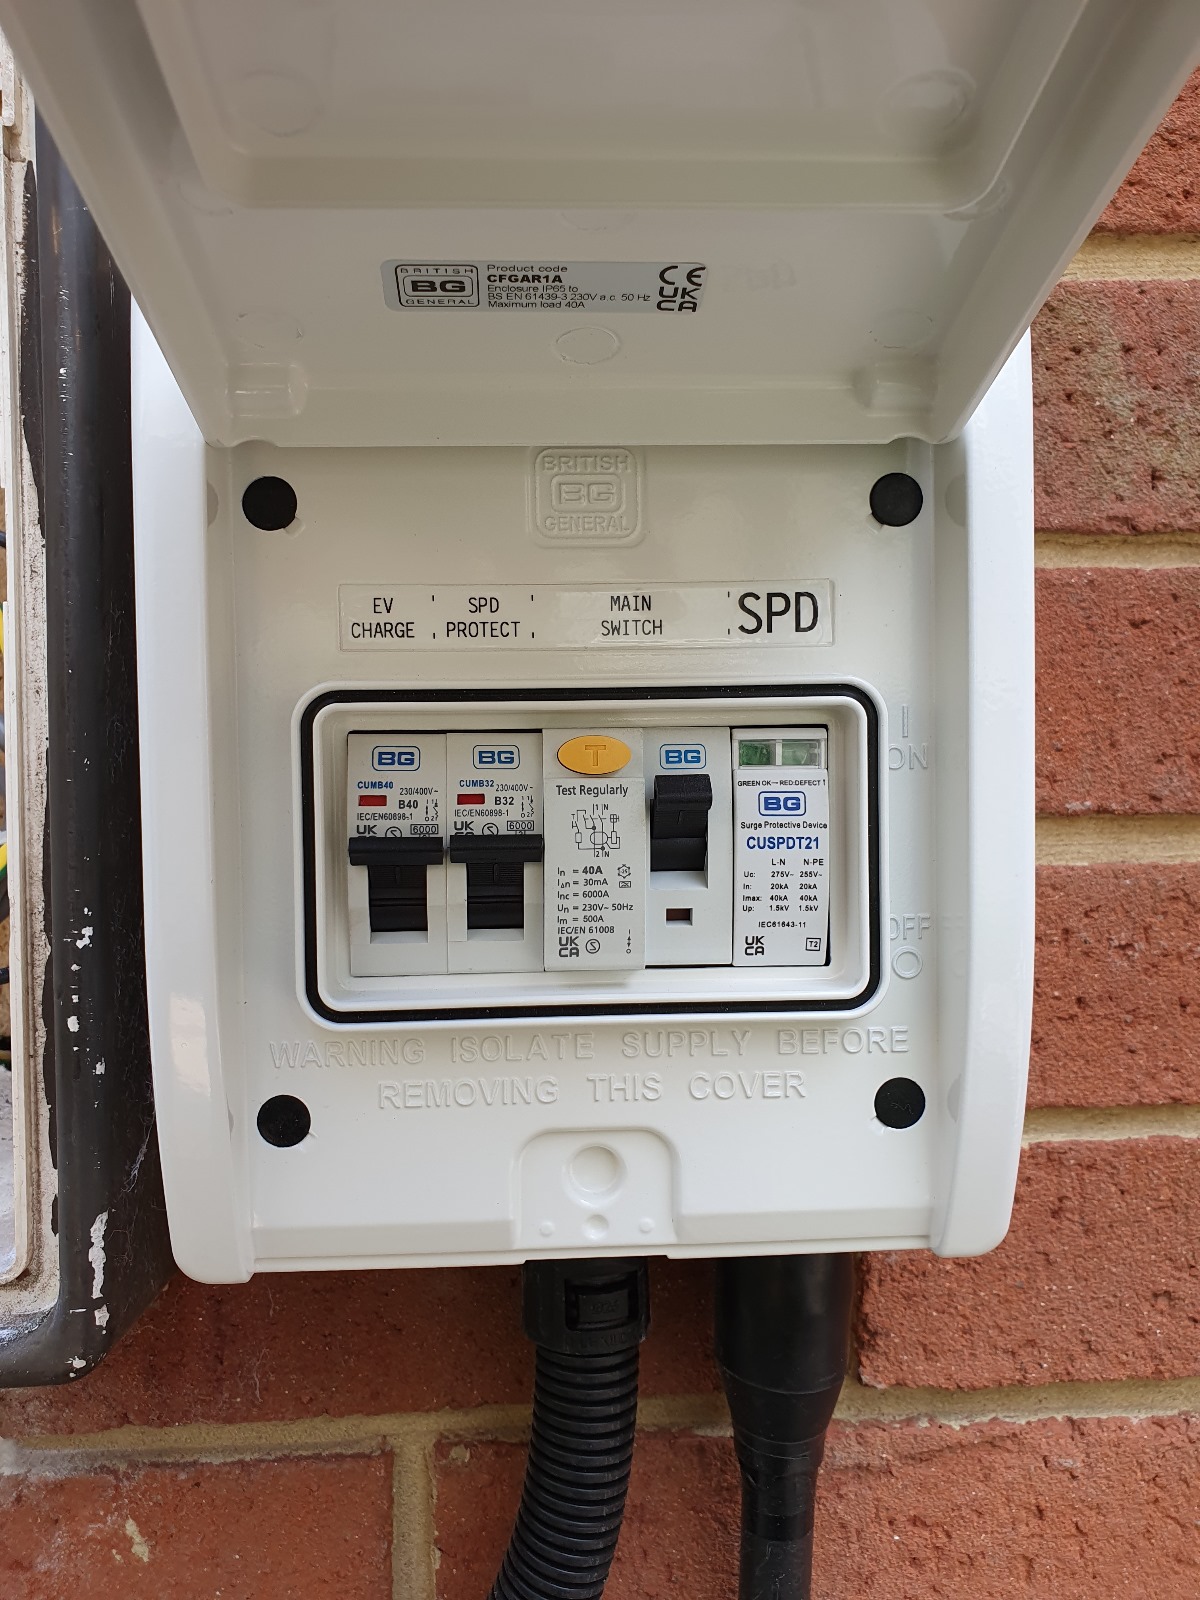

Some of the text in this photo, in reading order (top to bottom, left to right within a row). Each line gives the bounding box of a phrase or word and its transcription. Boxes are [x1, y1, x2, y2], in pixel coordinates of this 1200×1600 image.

[487, 264, 568, 273] Product code
[487, 274, 563, 284] CFGAR1A
[658, 265, 707, 287] CE
[411, 280, 466, 293] BG
[487, 284, 579, 293] Enclosure IP65 to
[488, 293, 503, 301] BS
[506, 293, 523, 301] EN
[525, 292, 568, 301] 61439-3
[570, 292, 598, 301] 230V
[621, 293, 635, 302] 50
[637, 293, 651, 302] Hz
[658, 287, 700, 300] UK
[488, 300, 586, 309] Maximum load 40A
[656, 300, 698, 312] CA
[542, 455, 631, 473] BRITISH
[559, 482, 617, 505] BG
[544, 515, 631, 533] GENERAL
[372, 597, 395, 615] EV
[467, 597, 500, 615] SPD
[610, 595, 652, 613] MAIN
[737, 591, 820, 635] SPD
[350, 622, 416, 640] CHARGE
[445, 621, 521, 639] PROTECT
[600, 619, 664, 637] SWITCH
[377, 751, 415, 766] BG
[478, 750, 515, 765] BG
[585, 744, 606, 766] T
[665, 750, 701, 764] BG
[888, 743, 928, 770] ON
[357, 781, 394, 789] CUMB40
[459, 780, 495, 788] CUMB32
[556, 783, 629, 798] Test Regularly
[398, 800, 419, 809] B40
[494, 796, 515, 806] B32
[763, 797, 801, 811] BG
[357, 813, 413, 821] IEC/EN60898-1
[454, 808, 509, 817] IEC/EN60898-1
[356, 824, 378, 835] UK
[412, 825, 437, 834] 6000
[453, 820, 475, 831] UK
[508, 821, 533, 830] 6000
[740, 821, 828, 830] Surge Protective Device
[746, 836, 819, 850] CUSPDT21
[771, 858, 824, 866] L-N N-PE
[582, 865, 604, 875] 40A
[583, 878, 609, 886] 30mA
[582, 890, 610, 898] 6000A
[611, 903, 634, 911] 50Hz
[742, 905, 755, 913] Up:
[582, 915, 605, 923] 500A
[557, 926, 615, 935] IEC/EN 61008
[558, 936, 580, 947] UK
[745, 935, 765, 946] UK
[808, 940, 819, 948] T2
[558, 947, 580, 958] CA
[744, 946, 765, 956] CA
[269, 1026, 910, 1069] WARNING ISOLATE SUPPLY BEFORE
[377, 1070, 808, 1109] REMOVING THIS COVER
